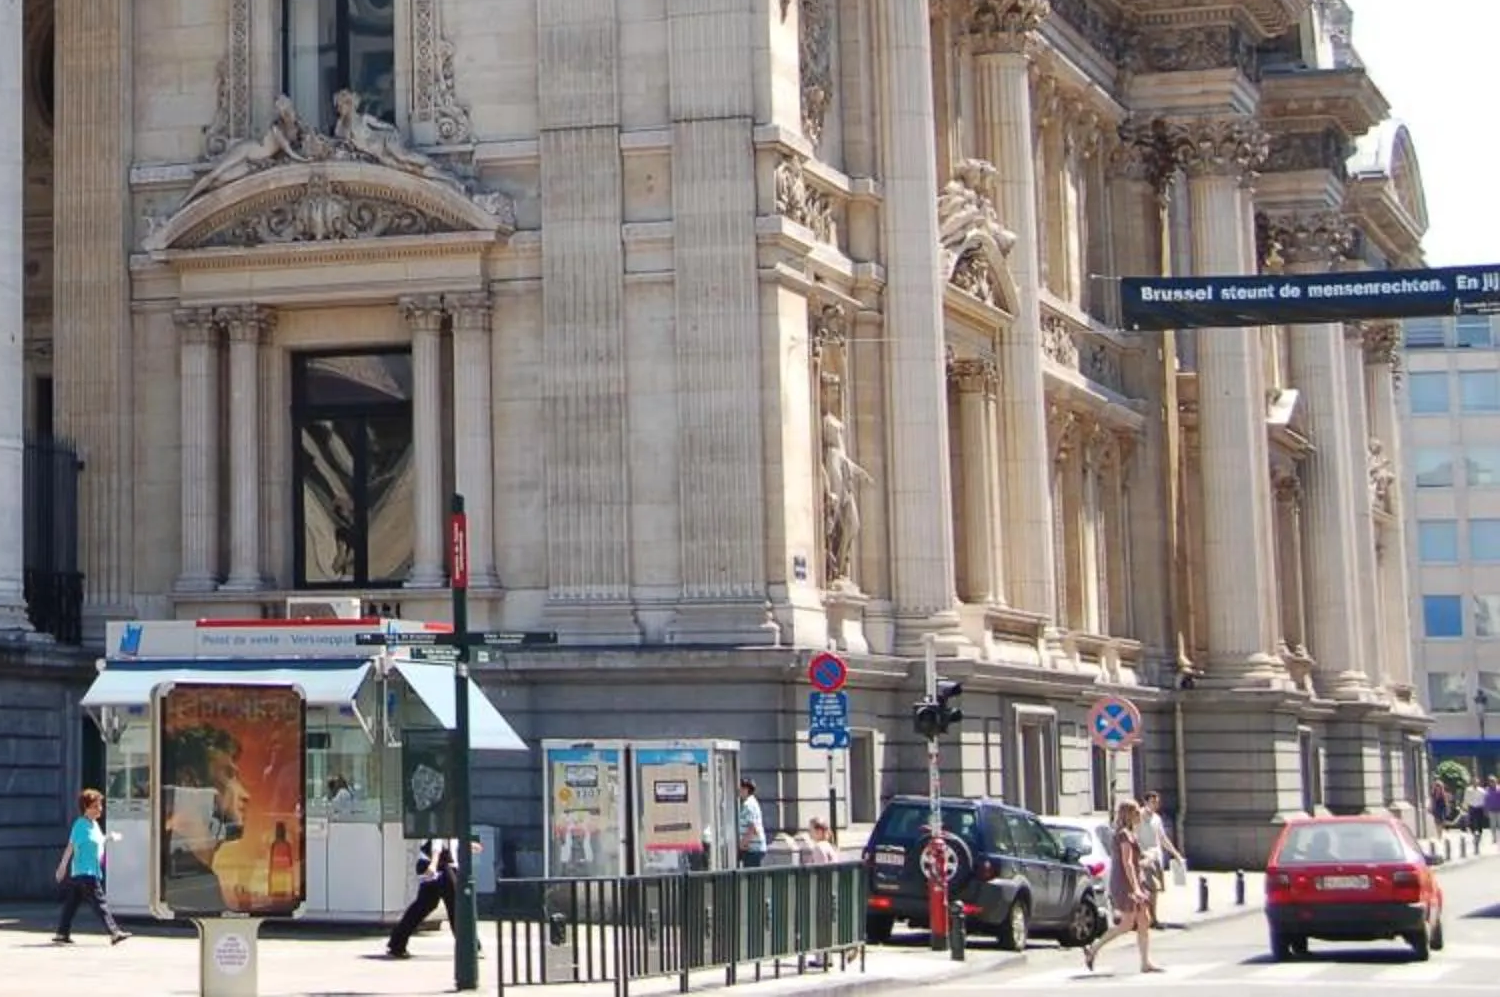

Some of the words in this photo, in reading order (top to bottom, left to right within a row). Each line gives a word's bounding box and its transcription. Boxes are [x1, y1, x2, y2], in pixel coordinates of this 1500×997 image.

[1140, 286, 1213, 302] Brussel
[1220, 284, 1275, 300] steunt
[1279, 282, 1301, 298] de
[1456, 274, 1478, 290] En
